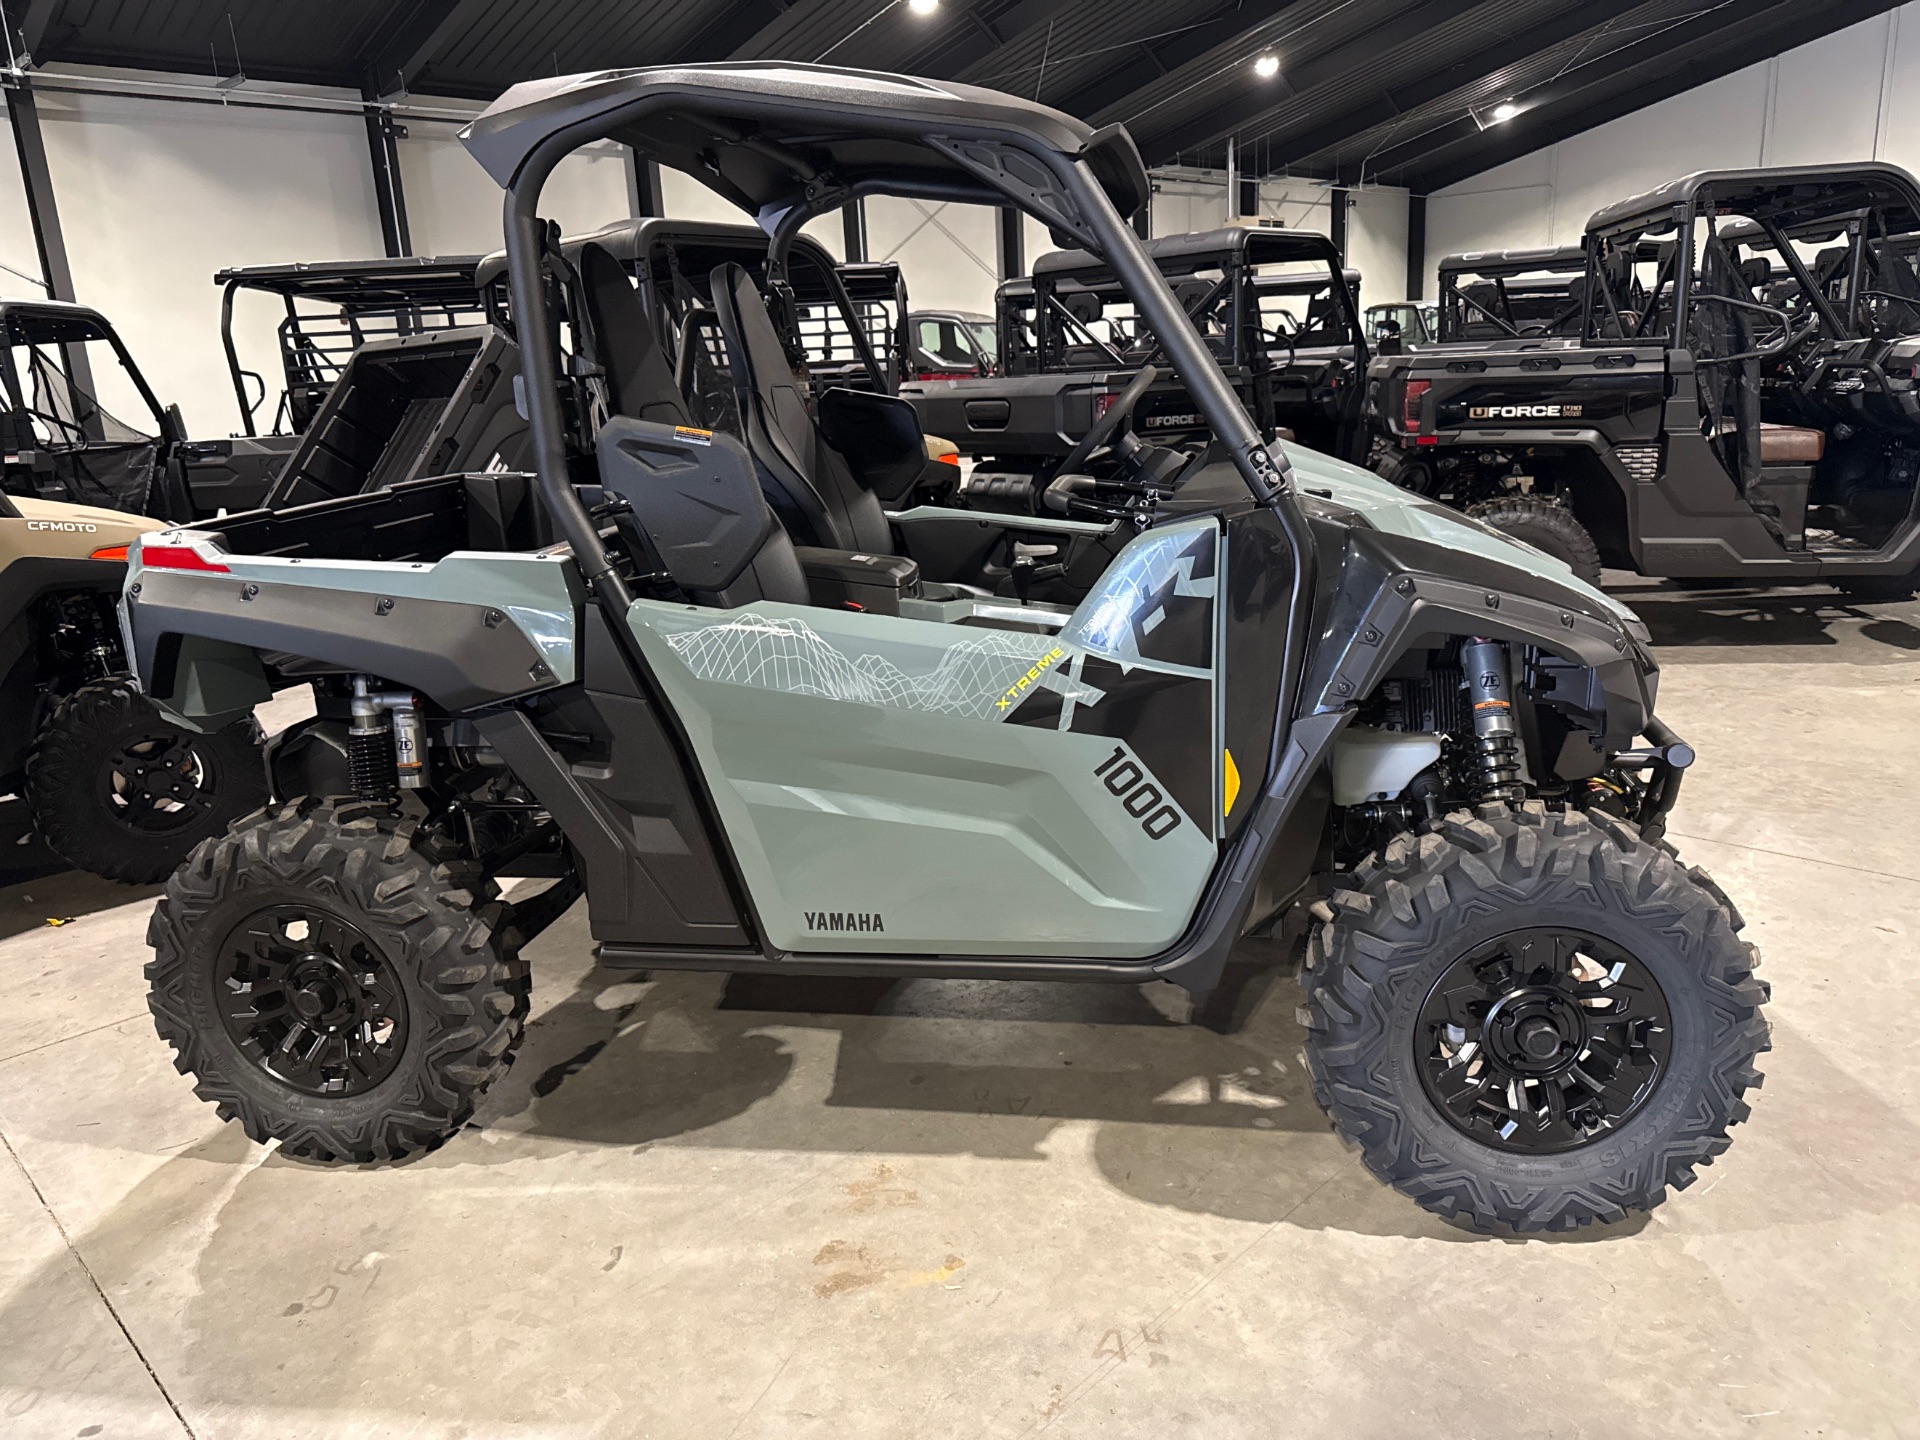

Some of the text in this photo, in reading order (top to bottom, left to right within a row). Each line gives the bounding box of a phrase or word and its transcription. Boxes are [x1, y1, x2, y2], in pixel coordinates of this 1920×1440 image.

[1470, 405, 1560, 418] UFORCE
[1146, 414, 1194, 427] UFORCE
[27, 521, 97, 533] CFMOTO
[995, 646, 1065, 712] XTREME
[1094, 746, 1182, 841] 1000
[804, 912, 885, 932] YAMAHA
